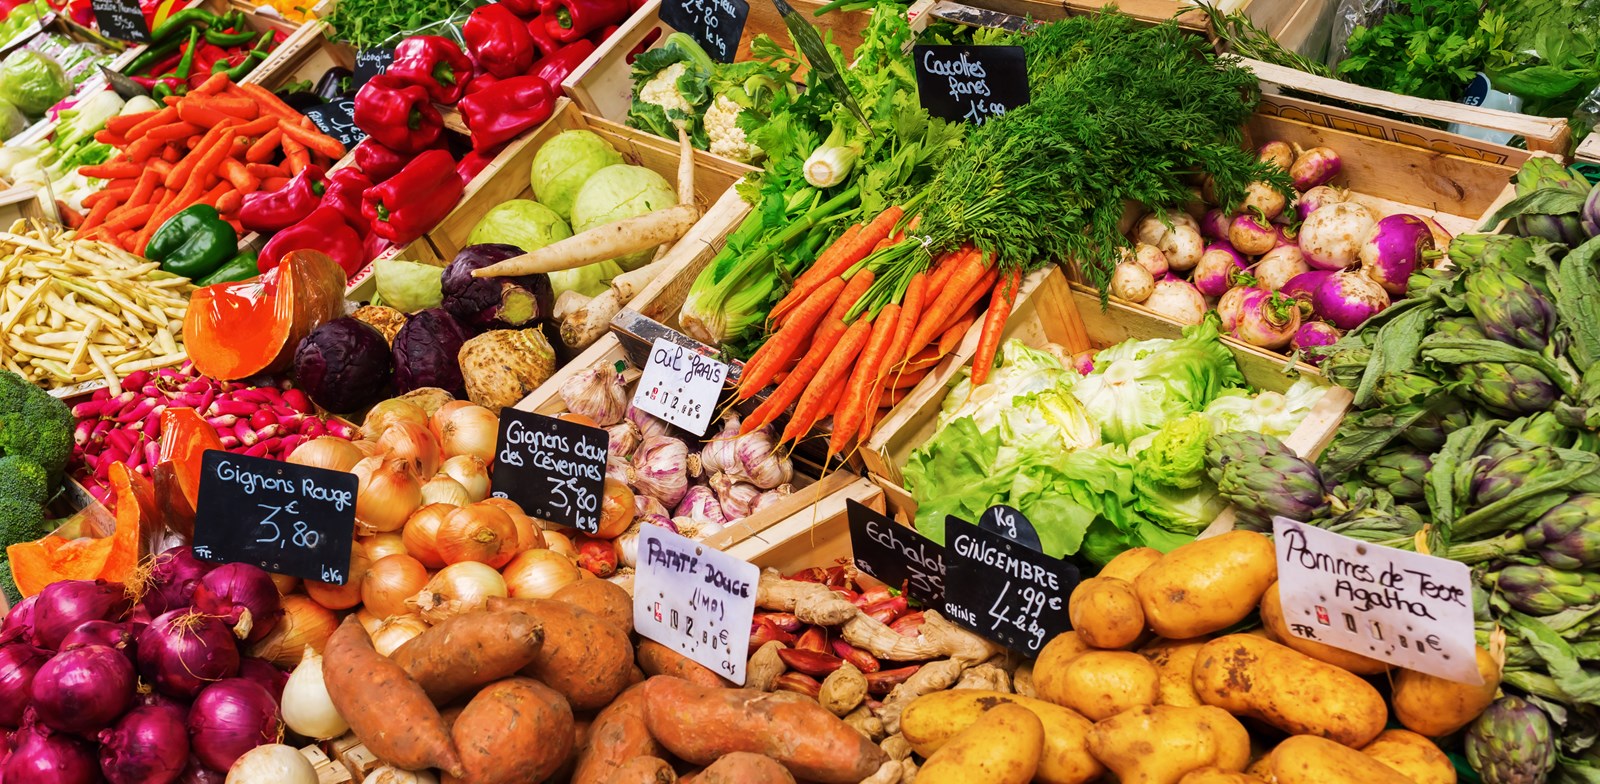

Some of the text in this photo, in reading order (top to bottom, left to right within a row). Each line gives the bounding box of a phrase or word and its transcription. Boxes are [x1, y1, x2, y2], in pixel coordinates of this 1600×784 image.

[500, 442, 602, 481] des Cévennes
[302, 478, 352, 512] Rouge
[576, 510, 586, 530] le
[647, 537, 750, 599] PATATE DOUCE
[866, 521, 947, 576] Echalot
[1282, 527, 1375, 583] Pommes
[1380, 562, 1404, 591] de
[1335, 579, 1437, 621] Agatha
